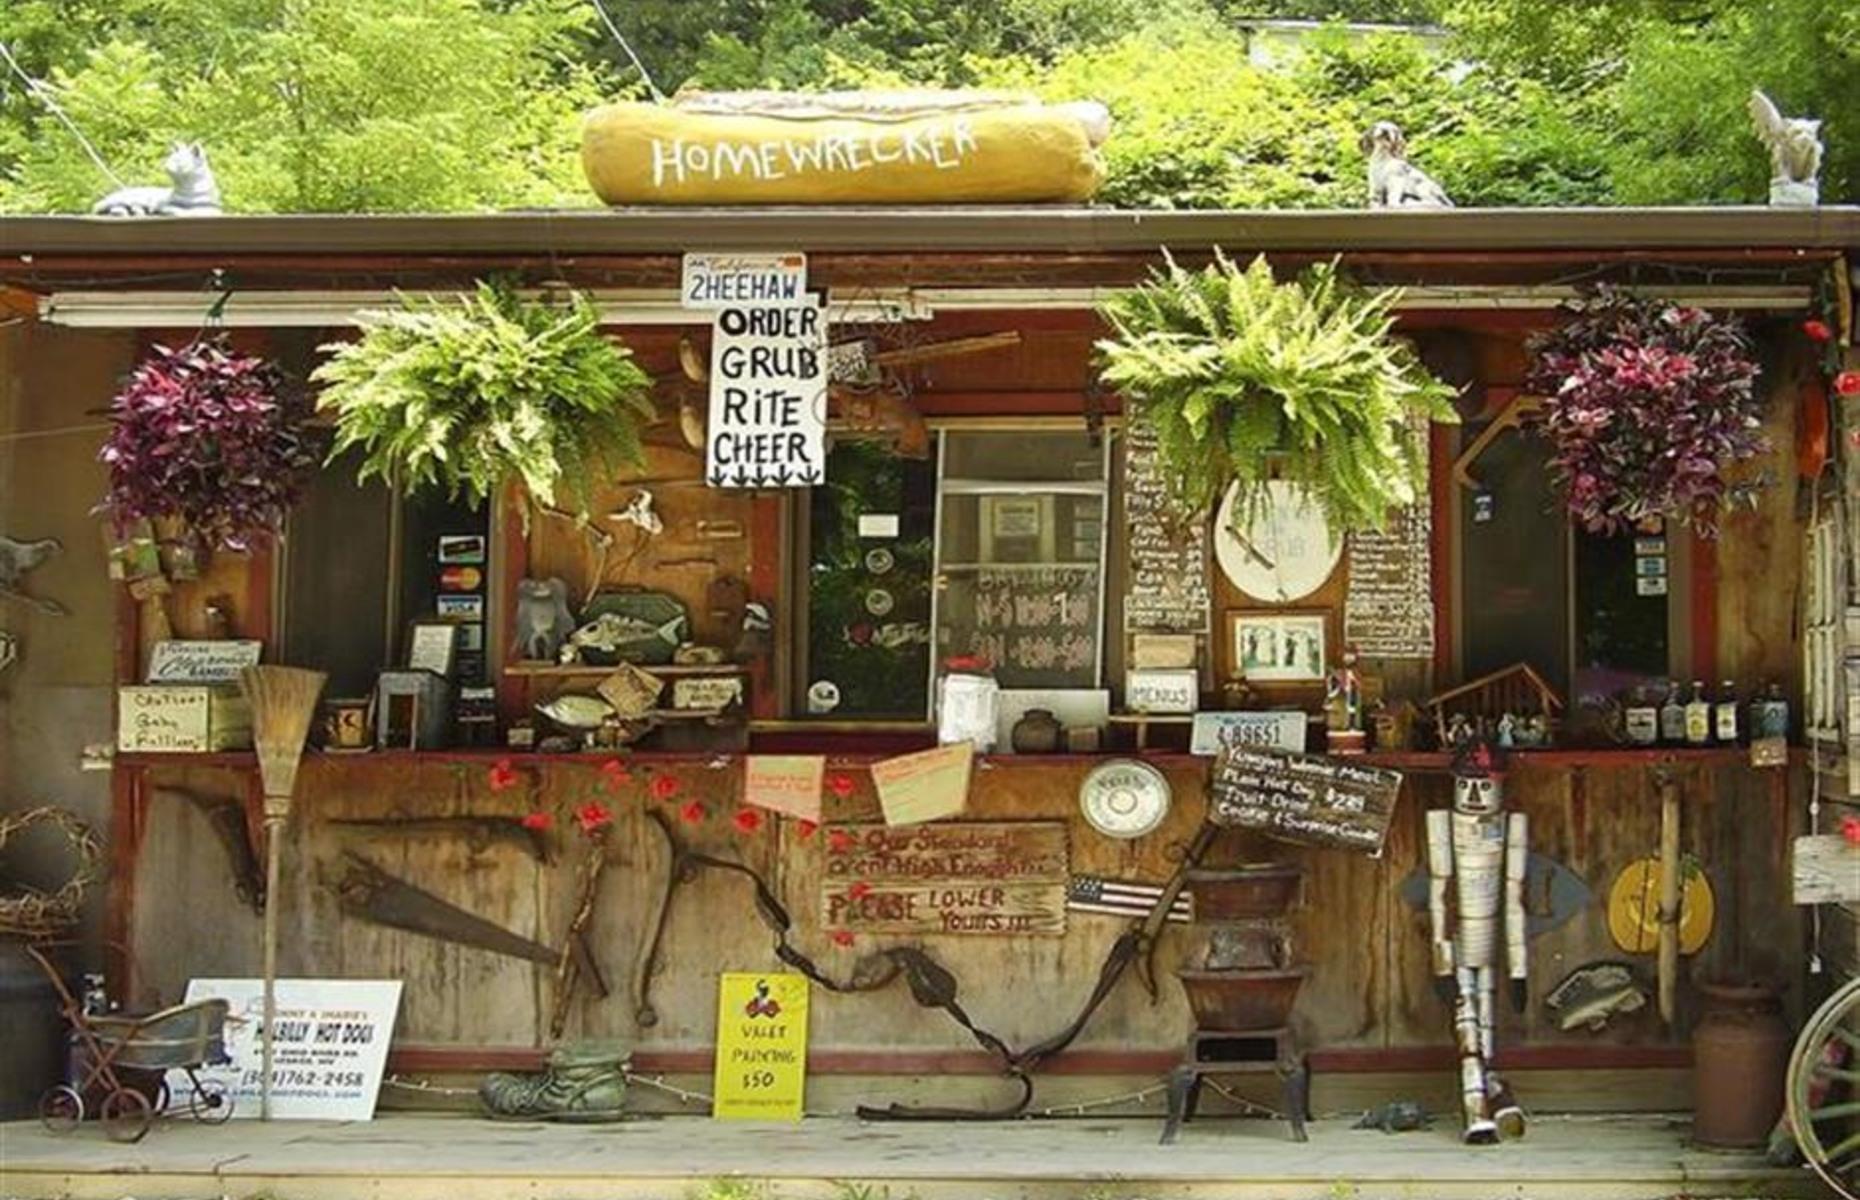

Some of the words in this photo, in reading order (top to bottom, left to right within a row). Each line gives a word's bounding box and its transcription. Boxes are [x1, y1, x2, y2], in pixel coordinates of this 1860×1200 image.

[652, 119, 978, 187] HOMEWRECKER
[690, 274, 797, 300] 2HEEHAW
[719, 307, 818, 338] ORDER
[720, 345, 819, 379] GRUB
[713, 432, 811, 465] CHEER
[929, 888, 1004, 908] LOWER
[313, 1022, 341, 1043] HOT
